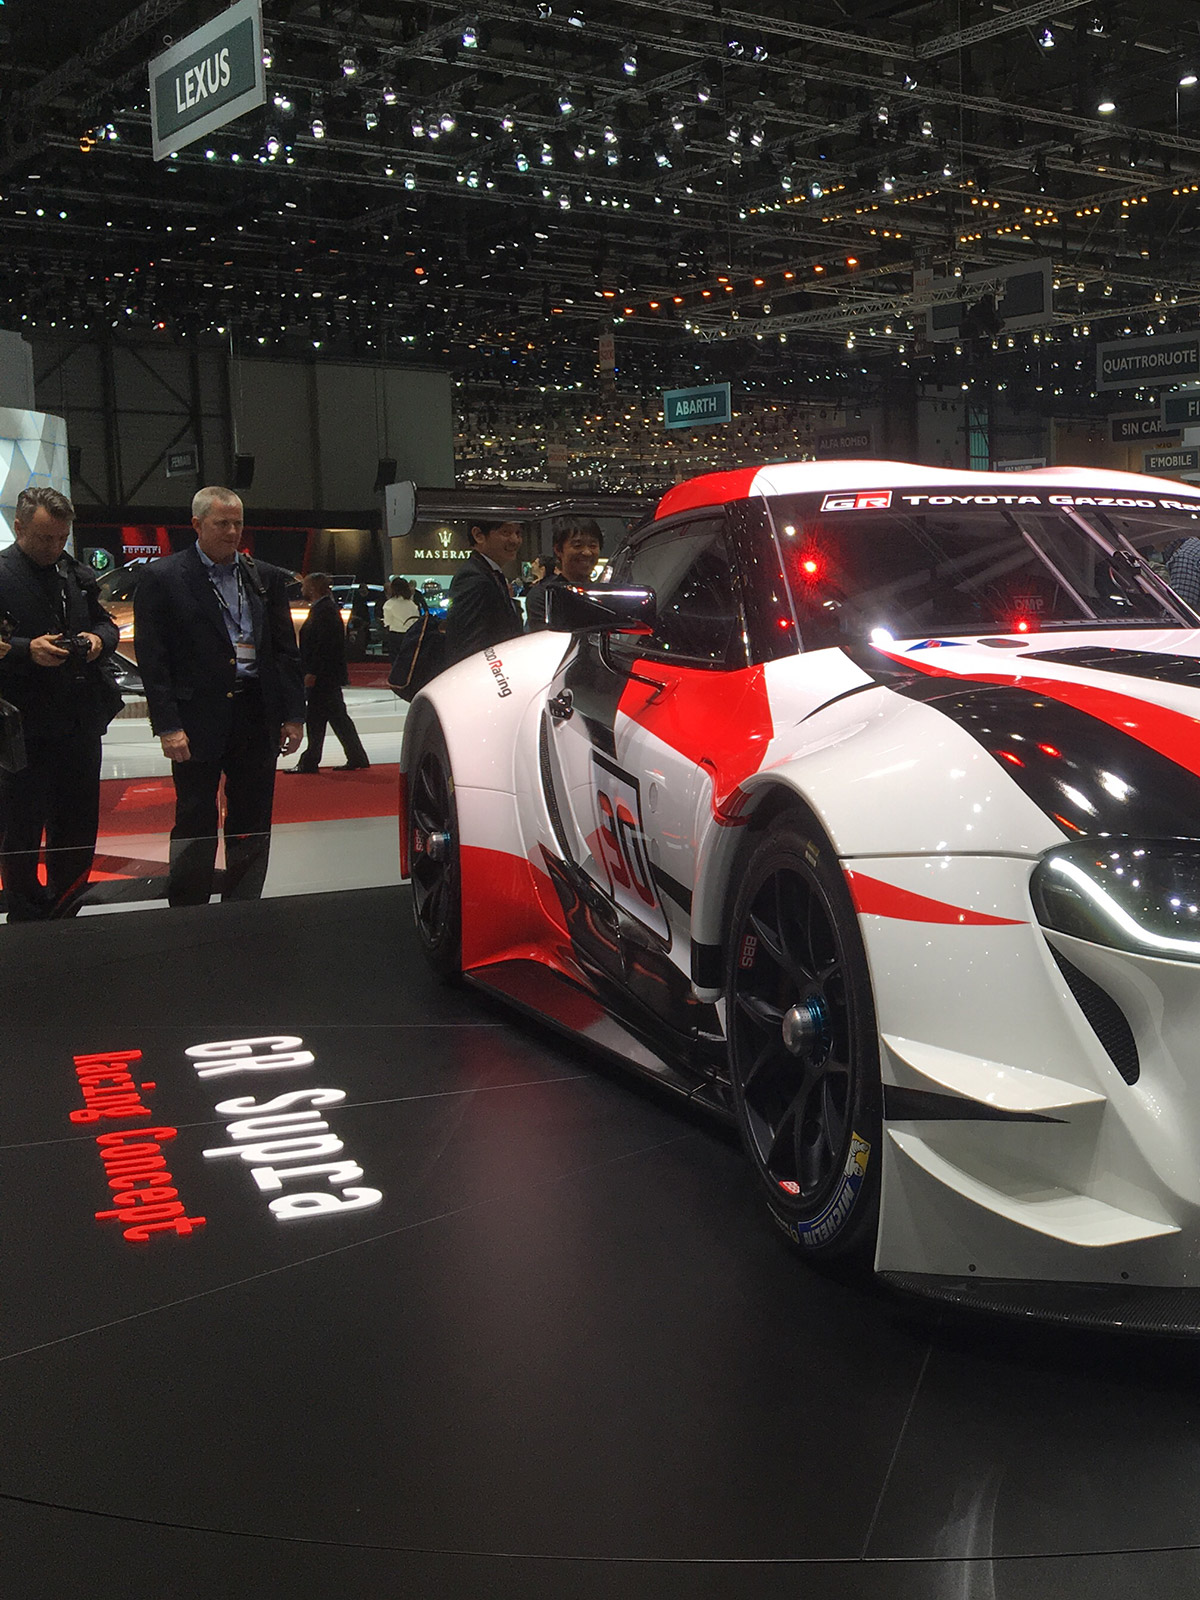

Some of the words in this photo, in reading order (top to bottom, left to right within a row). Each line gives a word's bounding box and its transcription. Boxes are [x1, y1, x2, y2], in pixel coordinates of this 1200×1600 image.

[175, 47, 231, 113] LEXUS
[1103, 349, 1198, 374] QUATTRORUOTE
[675, 397, 717, 416] ABARTH
[1121, 422, 1140, 435] SIN
[1150, 455, 1192, 468] E'MOBILE
[824, 497, 890, 510] GR
[902, 495, 1042, 506] TOYOTA
[1048, 495, 1157, 508] GAZOO
[122, 545, 162, 555] Ferrari
[489, 659, 512, 698] Racing
[742, 935, 758, 968] BBS
[185, 1036, 315, 1078] GR
[69, 1049, 156, 1123] Racing
[202, 1088, 383, 1220] Supra
[95, 1127, 206, 1241] Concept
